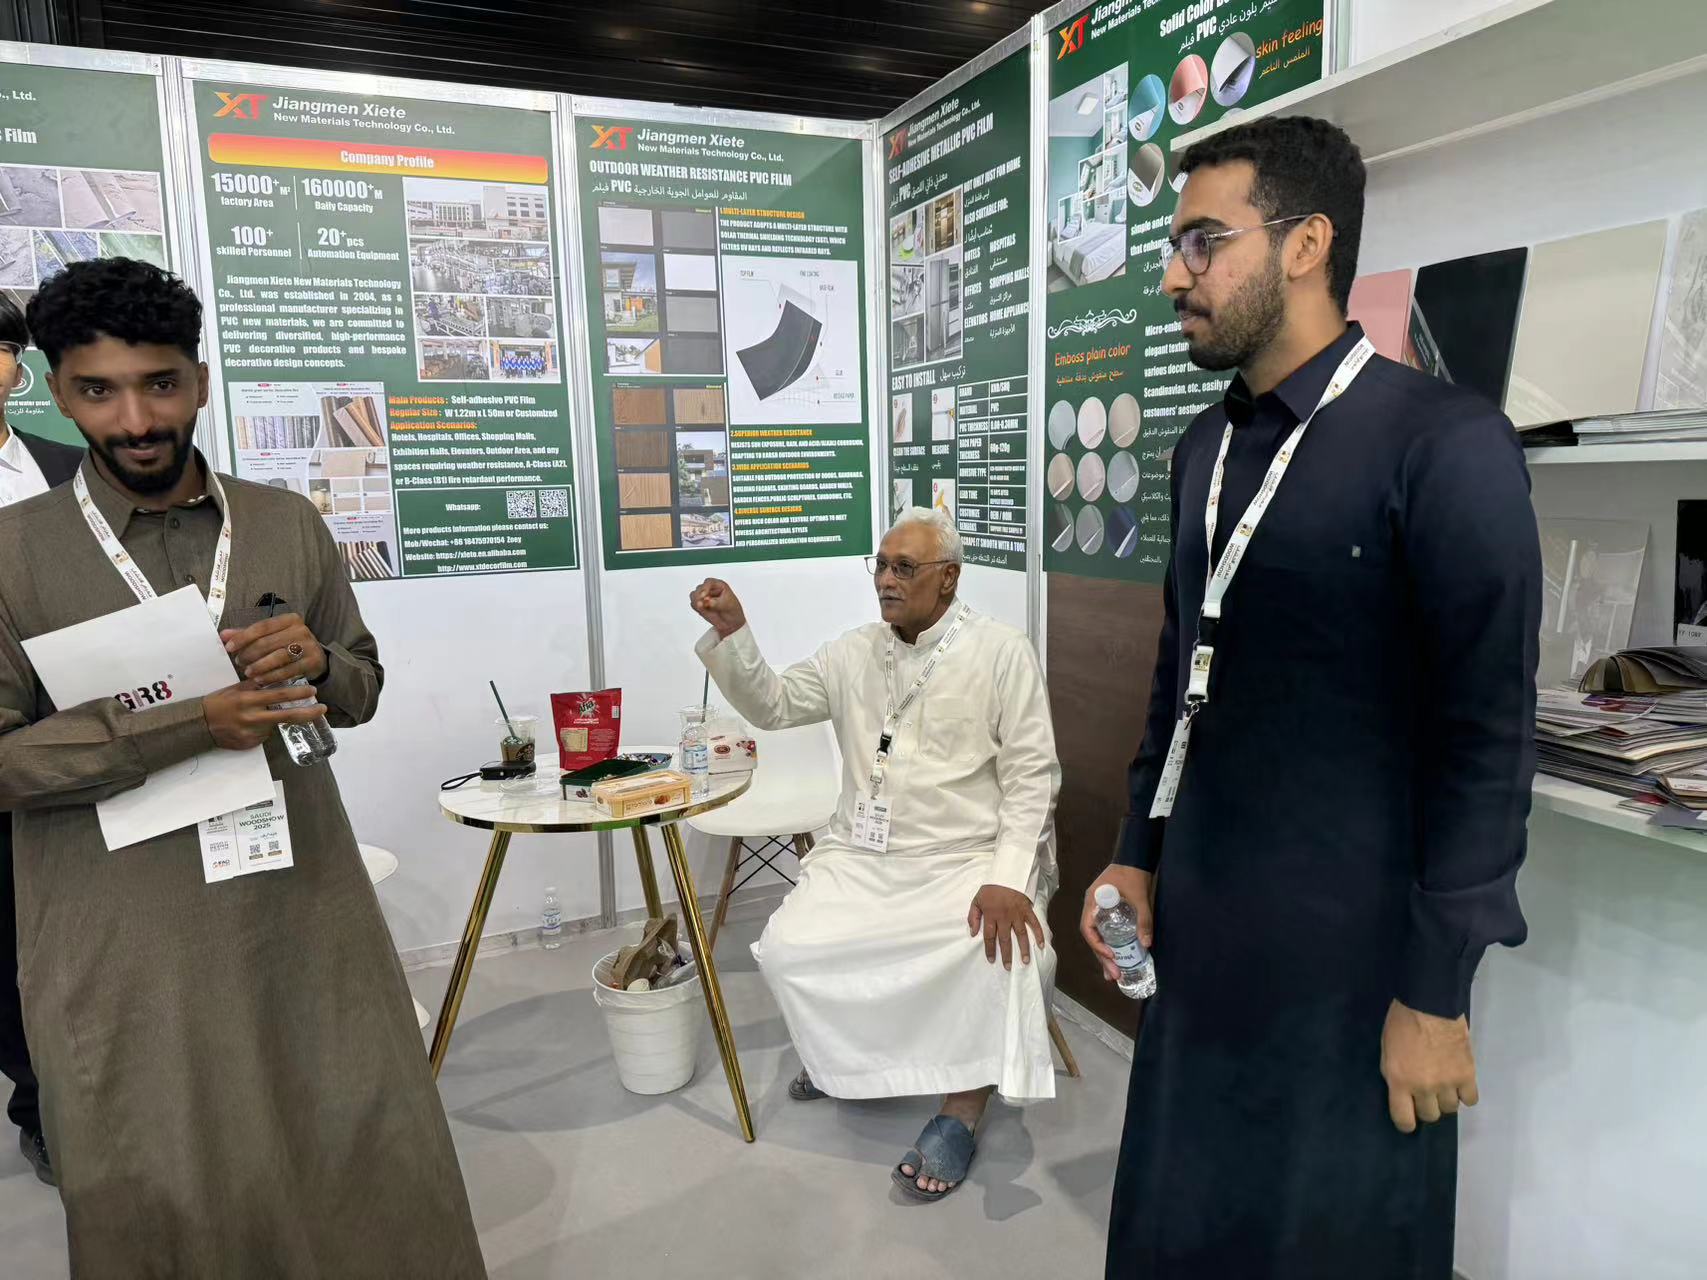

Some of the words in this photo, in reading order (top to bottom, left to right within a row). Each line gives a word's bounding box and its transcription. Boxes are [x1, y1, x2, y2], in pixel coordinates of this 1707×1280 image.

[1091, 25, 1107, 40] New
[1108, 5, 1142, 31] Materials
[1159, 8, 1186, 38] Solid
[1196, 15, 1218, 41] PVC
[1255, 38, 1279, 59] skin
[1281, 18, 1324, 49] feeling
[12, 90, 37, 101] Ltd.
[272, 96, 358, 116] Jiangmen
[362, 104, 406, 118] Xiete
[273, 112, 298, 123] New
[300, 114, 350, 128] Materials
[352, 118, 412, 133] Technology
[414, 124, 434, 135] Co.,
[436, 125, 456, 135] Ltd.
[4, 127, 38, 144] Film
[637, 128, 707, 146] Jiangmen
[708, 134, 745, 149] Xiete
[637, 143, 658, 152] New
[659, 144, 700, 156] Materials
[700, 148, 750, 161] Technology
[750, 152, 767, 161] Co.,
[768, 153, 784, 162] Ltd.
[889, 147, 931, 184] SELF-ADHESIVE
[930, 130, 961, 163] METALLIC
[961, 122, 977, 146] PVC
[976, 111, 994, 138] FILM
[340, 150, 395, 168] Company
[397, 154, 435, 169] Profile
[589, 163, 640, 175] OUTDOOR
[639, 166, 689, 180] WEATHER
[688, 168, 750, 183] RESISTANCE
[750, 171, 770, 185] PVC
[770, 173, 792, 186] FILM
[610, 179, 632, 193] PVC
[220, 196, 252, 207] factory
[253, 197, 274, 207] Area
[314, 201, 336, 212] Daily
[336, 202, 374, 214] Capacity
[346, 238, 364, 249] pcs
[216, 246, 247, 256] skilled
[246, 247, 292, 258] Personnel
[307, 249, 356, 260] Automation
[356, 250, 400, 262] Equipment
[227, 274, 269, 287] Jiangmen
[293, 277, 312, 287] New
[312, 277, 353, 288] Materials
[353, 278, 402, 291] Technology
[260, 291, 279, 299] was
[284, 290, 335, 300] established
[339, 291, 349, 300] in
[381, 294, 392, 302] as
[219, 302, 276, 315] professional
[279, 304, 338, 315] manufacturer
[341, 305, 392, 316] specializing
[395, 306, 404, 316] in
[220, 316, 239, 327] PVC
[242, 318, 262, 327] new
[312, 319, 326, 328] we
[329, 319, 344, 328] are
[347, 318, 393, 329] committed
[395, 320, 405, 329] to
[222, 330, 268, 342] delivering
[331, 331, 406, 343] high-performance
[223, 344, 241, 353] PVC
[249, 344, 296, 354] decorative
[303, 345, 341, 356] products
[348, 345, 365, 354] and
[371, 345, 407, 356] bespoke
[1055, 351, 1085, 368] Emboss
[1086, 347, 1107, 365] plain
[1108, 343, 1133, 358] color
[1144, 344, 1168, 357] elegant
[224, 357, 273, 368] decorative
[273, 358, 303, 370] design
[303, 358, 346, 369] concepts.
[1143, 365, 1167, 377] various
[1168, 362, 1187, 375] decor
[892, 373, 907, 394] EASY
[906, 372, 914, 392] TO
[913, 369, 936, 390] INSTALL
[1143, 384, 1187, 398] Scandinavian,
[1202, 379, 1223, 392] easily
[450, 395, 503, 405] Self-adhesive
[503, 395, 519, 404] PVC
[519, 394, 536, 404] Film
[515, 408, 558, 418] Customized
[1143, 405, 1178, 418] customers'
[445, 503, 481, 512] Whatsapp:
[239, 814, 286, 828] WOODSHOW
